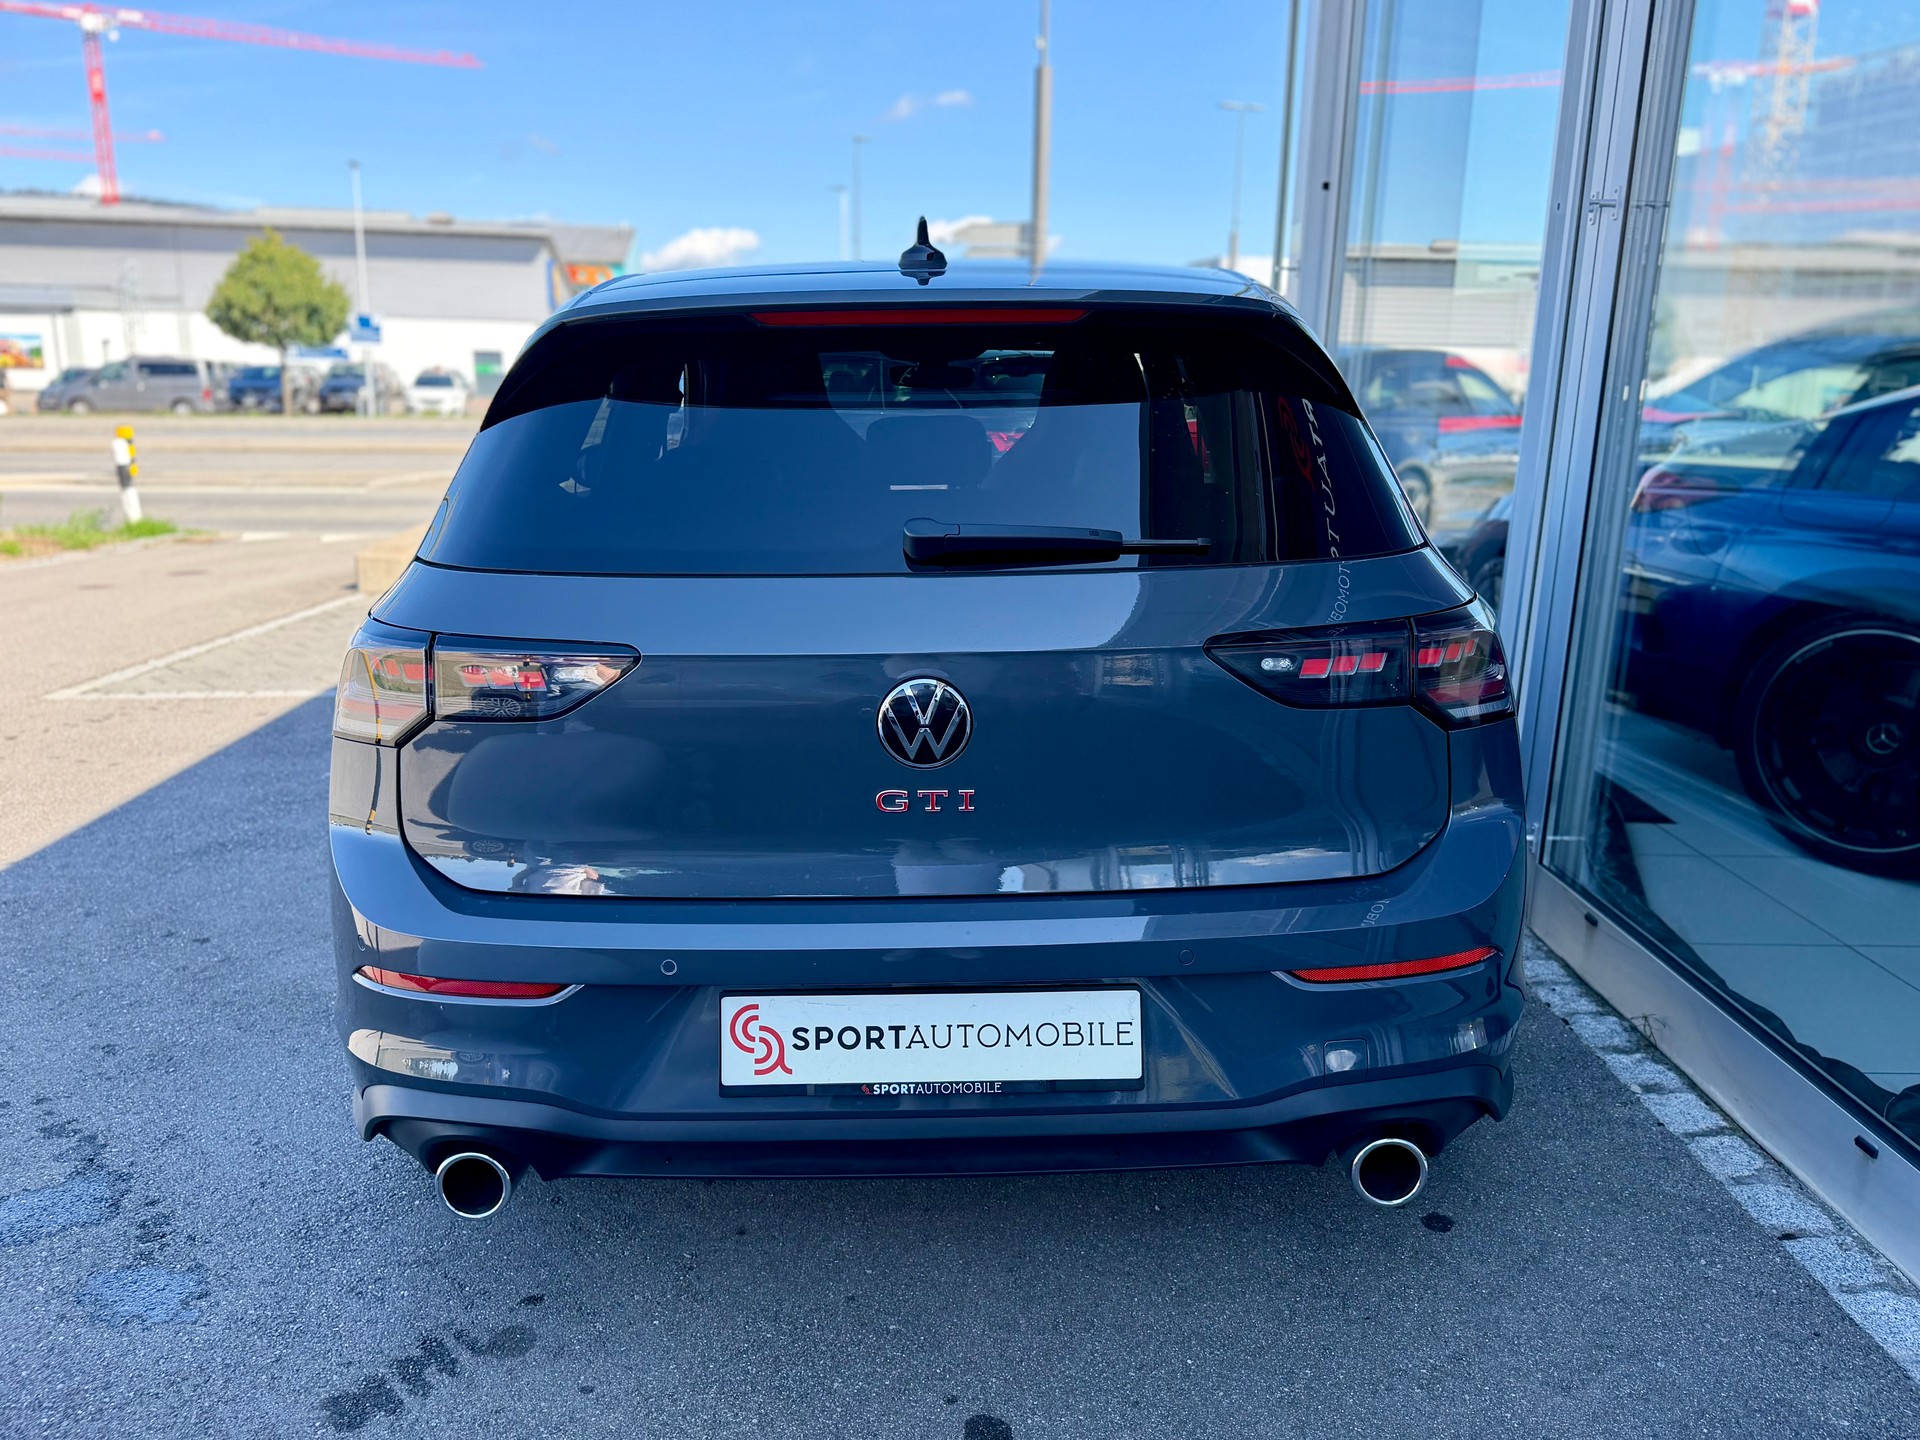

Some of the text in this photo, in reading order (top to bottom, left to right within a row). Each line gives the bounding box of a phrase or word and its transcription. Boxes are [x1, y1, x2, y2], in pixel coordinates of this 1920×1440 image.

[875, 789, 975, 813] GTI
[791, 1021, 1134, 1051] SPORTAUTOMOBILE
[873, 1082, 1002, 1095] SPORTAUTOMOBILE
